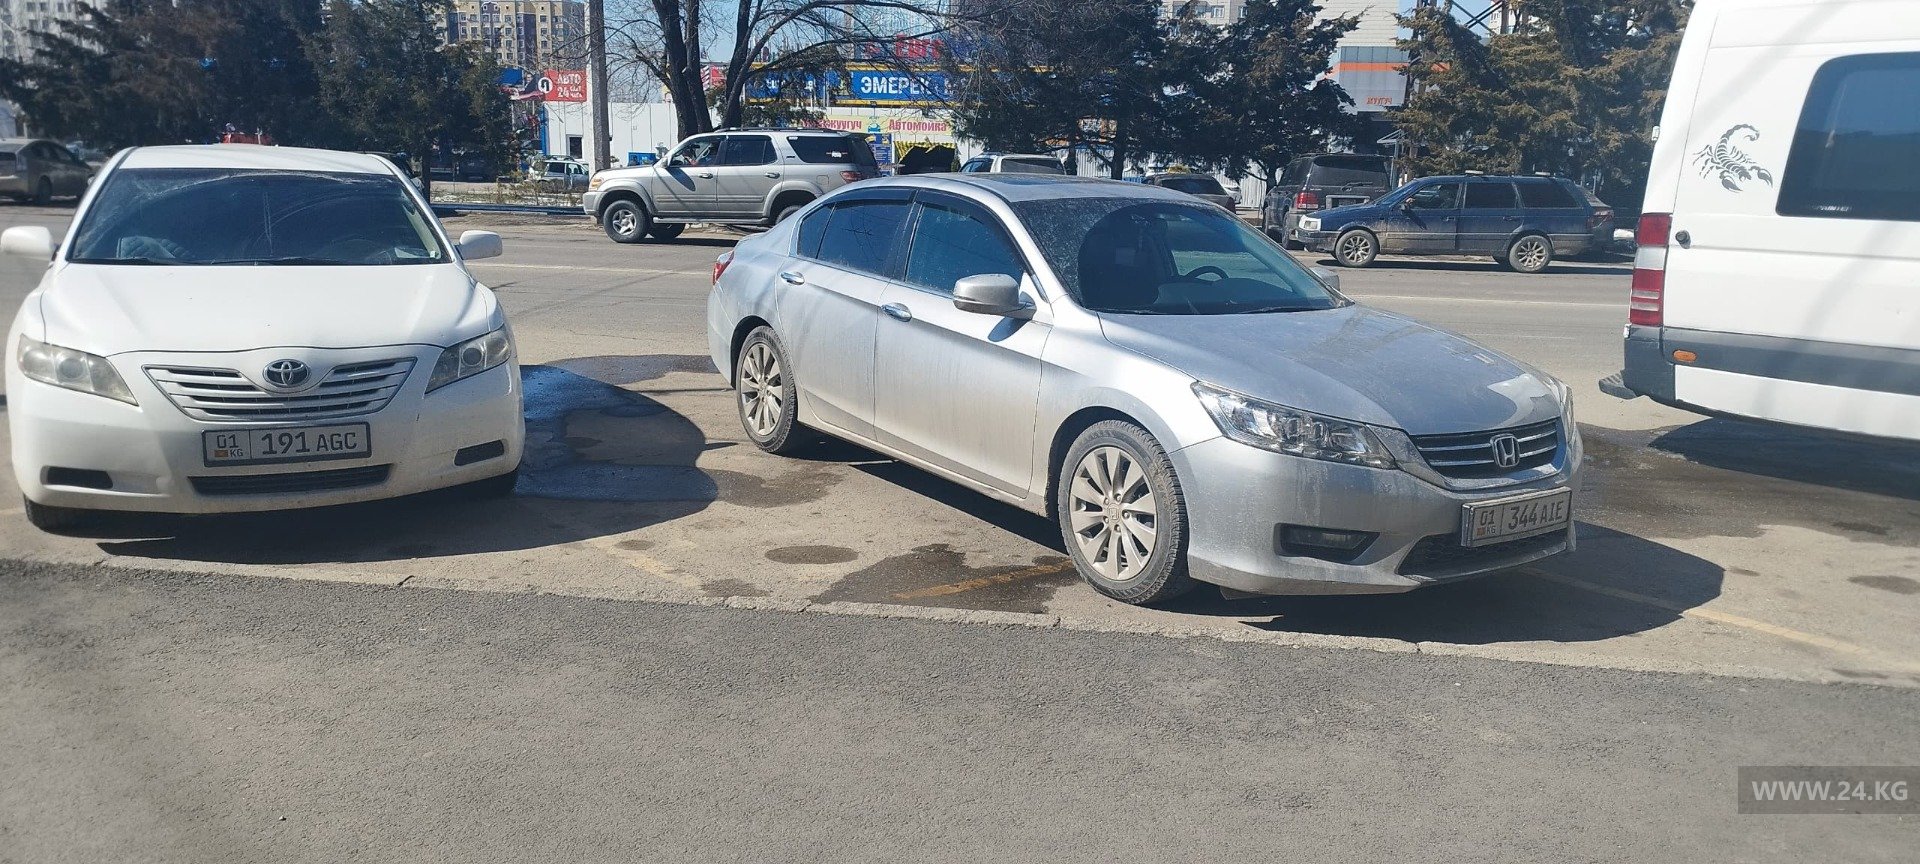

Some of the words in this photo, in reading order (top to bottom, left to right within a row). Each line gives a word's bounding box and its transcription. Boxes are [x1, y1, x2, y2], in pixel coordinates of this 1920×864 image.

[558, 73, 581, 85] АВТО
[557, 86, 570, 98] 24
[888, 118, 947, 132] Автомойка
[216, 434, 239, 449] 01
[261, 431, 311, 455] 191
[316, 432, 357, 452] AGC
[230, 449, 244, 457] KG
[1480, 509, 1495, 526] 01
[1508, 502, 1538, 530] 344
[1486, 525, 1496, 534] KG
